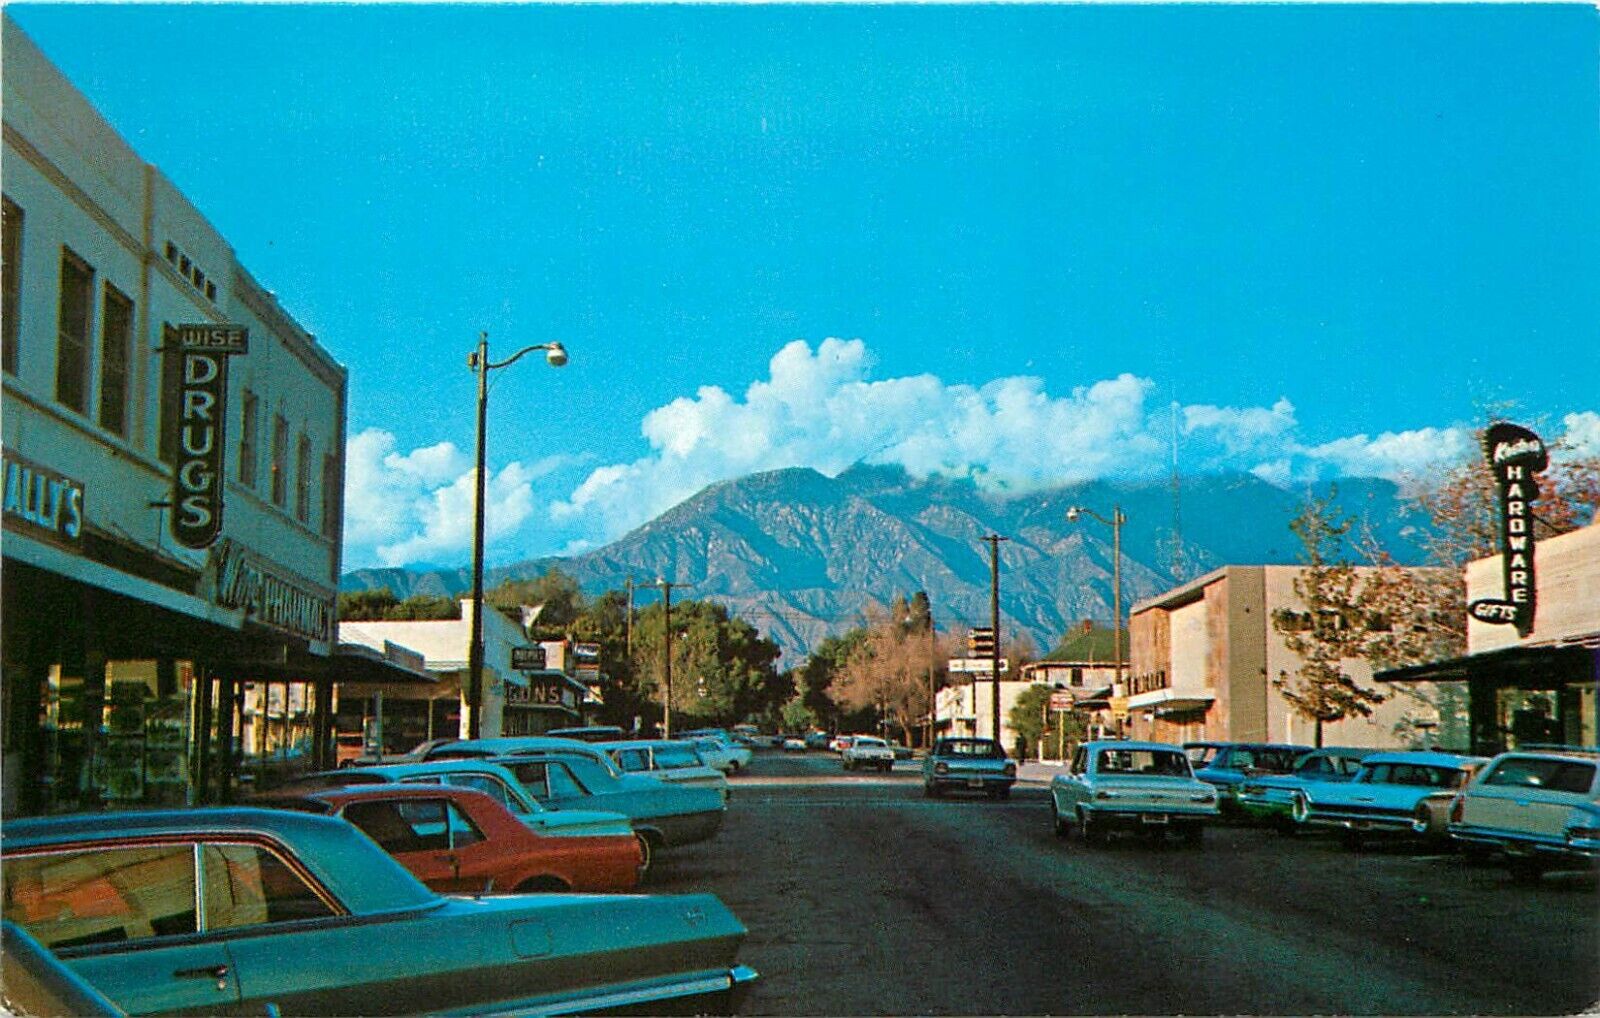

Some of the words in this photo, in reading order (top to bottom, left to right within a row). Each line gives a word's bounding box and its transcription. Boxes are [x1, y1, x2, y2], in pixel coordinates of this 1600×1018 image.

[182, 328, 243, 346] WISE
[179, 354, 218, 528] DRUGS
[2, 458, 81, 538] ALLY'S
[1507, 465, 1528, 602] HARDWARE
[1474, 602, 1517, 620] GIFTS
